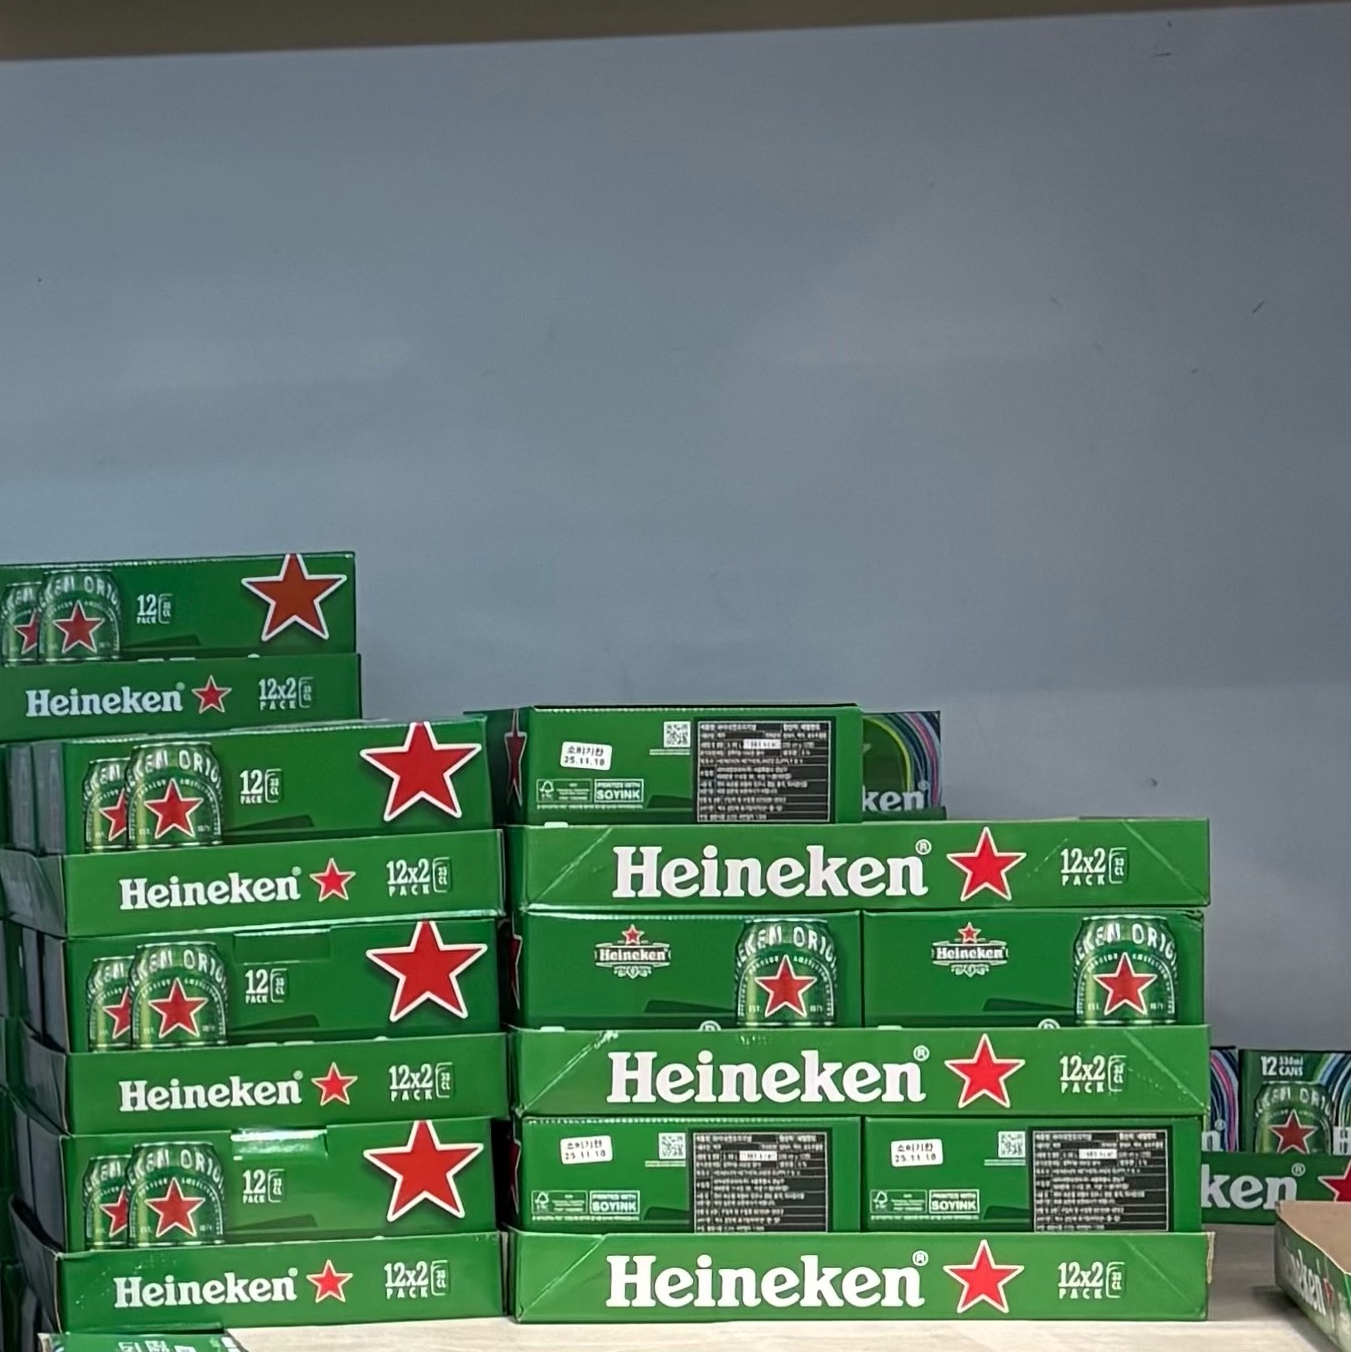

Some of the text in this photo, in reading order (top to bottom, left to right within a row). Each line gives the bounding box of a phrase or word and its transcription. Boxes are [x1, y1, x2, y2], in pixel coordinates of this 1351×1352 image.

[136, 595, 156, 615] 12
[258, 677, 296, 700] 12x2
[26, 687, 183, 717] Heineken
[239, 769, 262, 792] 12
[386, 859, 430, 884] 12x2
[612, 844, 929, 898] Heineken
[1060, 847, 1106, 874] 12x2
[119, 872, 300, 910] Heineken
[599, 948, 666, 962] Heineken
[936, 946, 1004, 960] Heineken
[244, 969, 267, 993] 12
[389, 1065, 432, 1089] 12x2
[606, 1050, 927, 1104] Heineken
[1060, 1056, 1105, 1081] 12x2
[1261, 1056, 1278, 1077] 12
[119, 1076, 302, 1112] Heineken
[242, 1170, 265, 1193] 12
[384, 1262, 428, 1287] 12x2
[605, 1255, 925, 1308] Heineken
[1058, 1262, 1104, 1288] 12x2
[114, 1272, 297, 1309] Heineken
